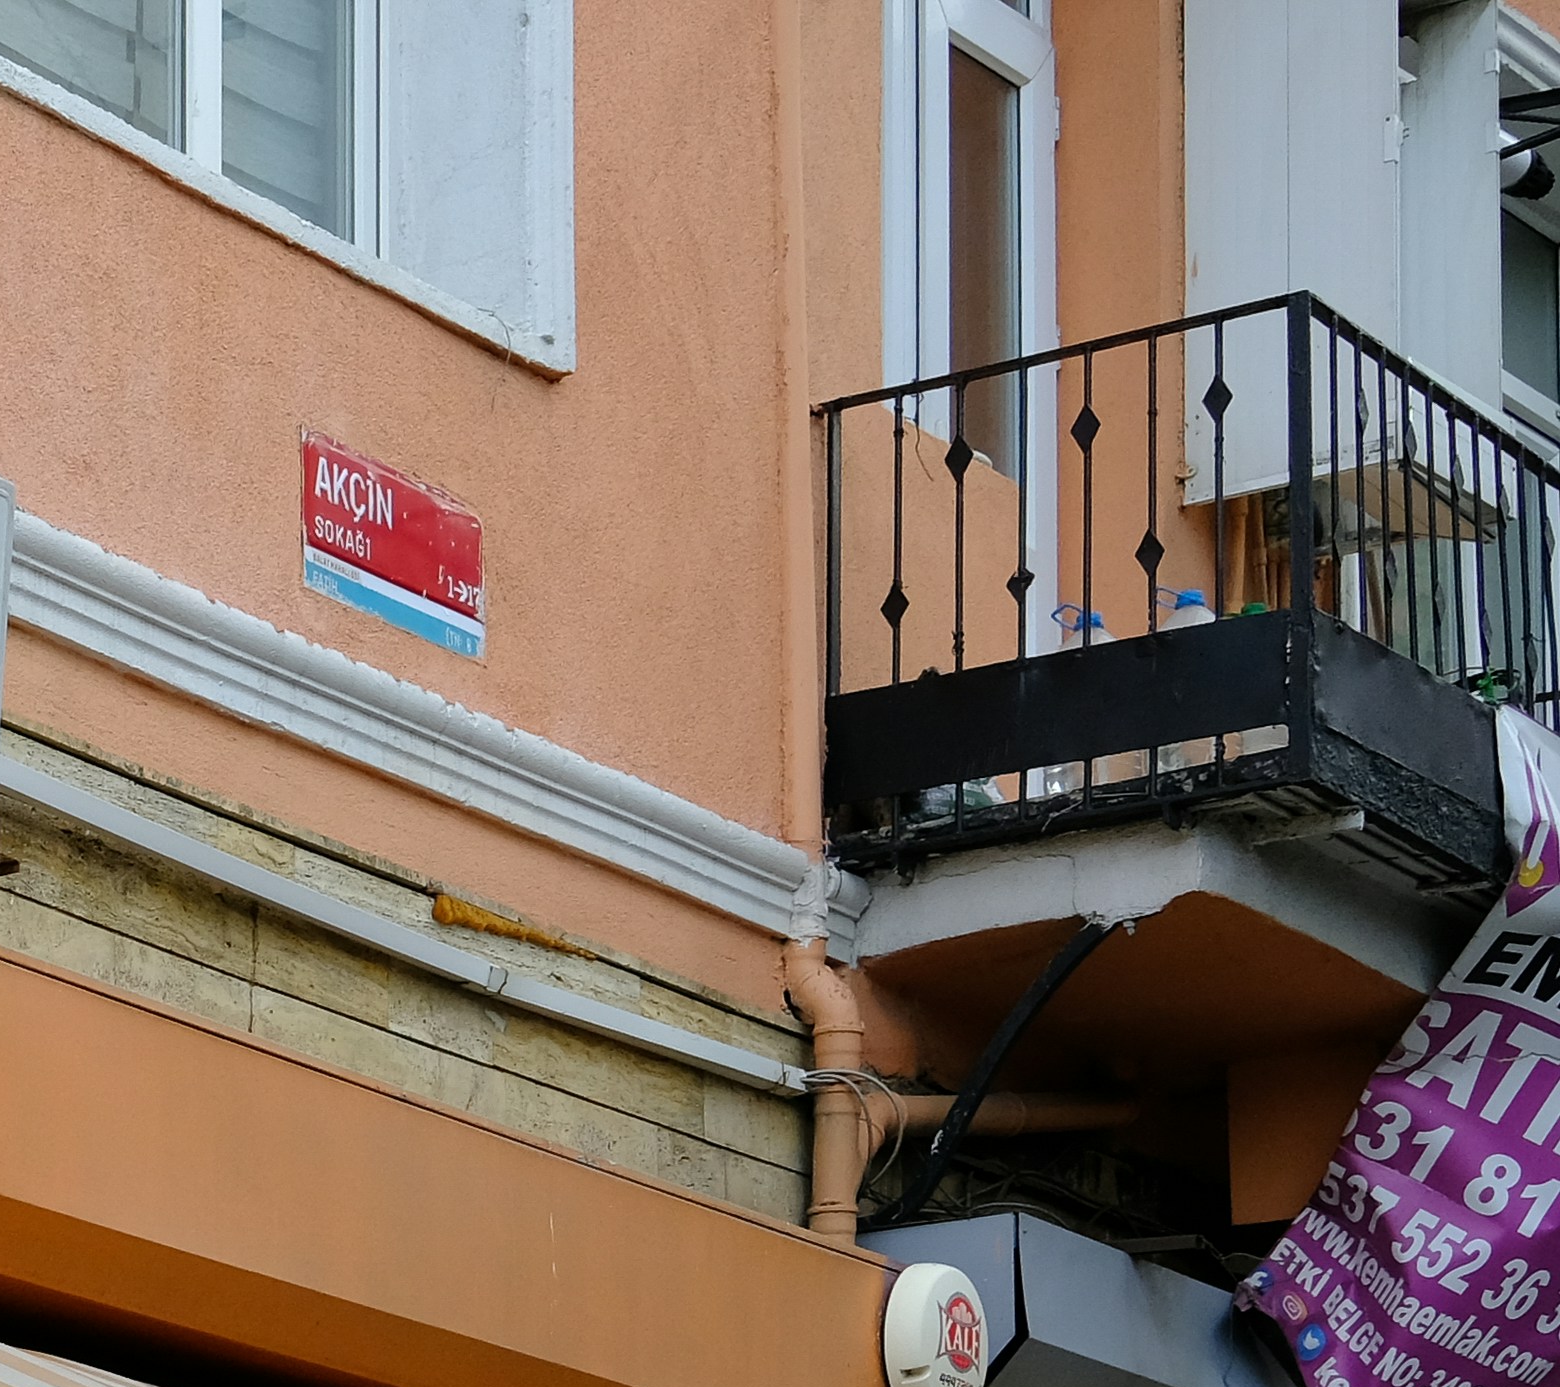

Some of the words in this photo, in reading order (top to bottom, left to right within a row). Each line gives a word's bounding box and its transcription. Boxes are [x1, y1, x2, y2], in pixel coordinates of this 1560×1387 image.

[314, 456, 393, 531] AKÇİN
[1391, 1208, 1492, 1296] 552
[1481, 1258, 1551, 1321] 36
[940, 1309, 982, 1366] KALE
[1321, 1284, 1385, 1367] BELGE
